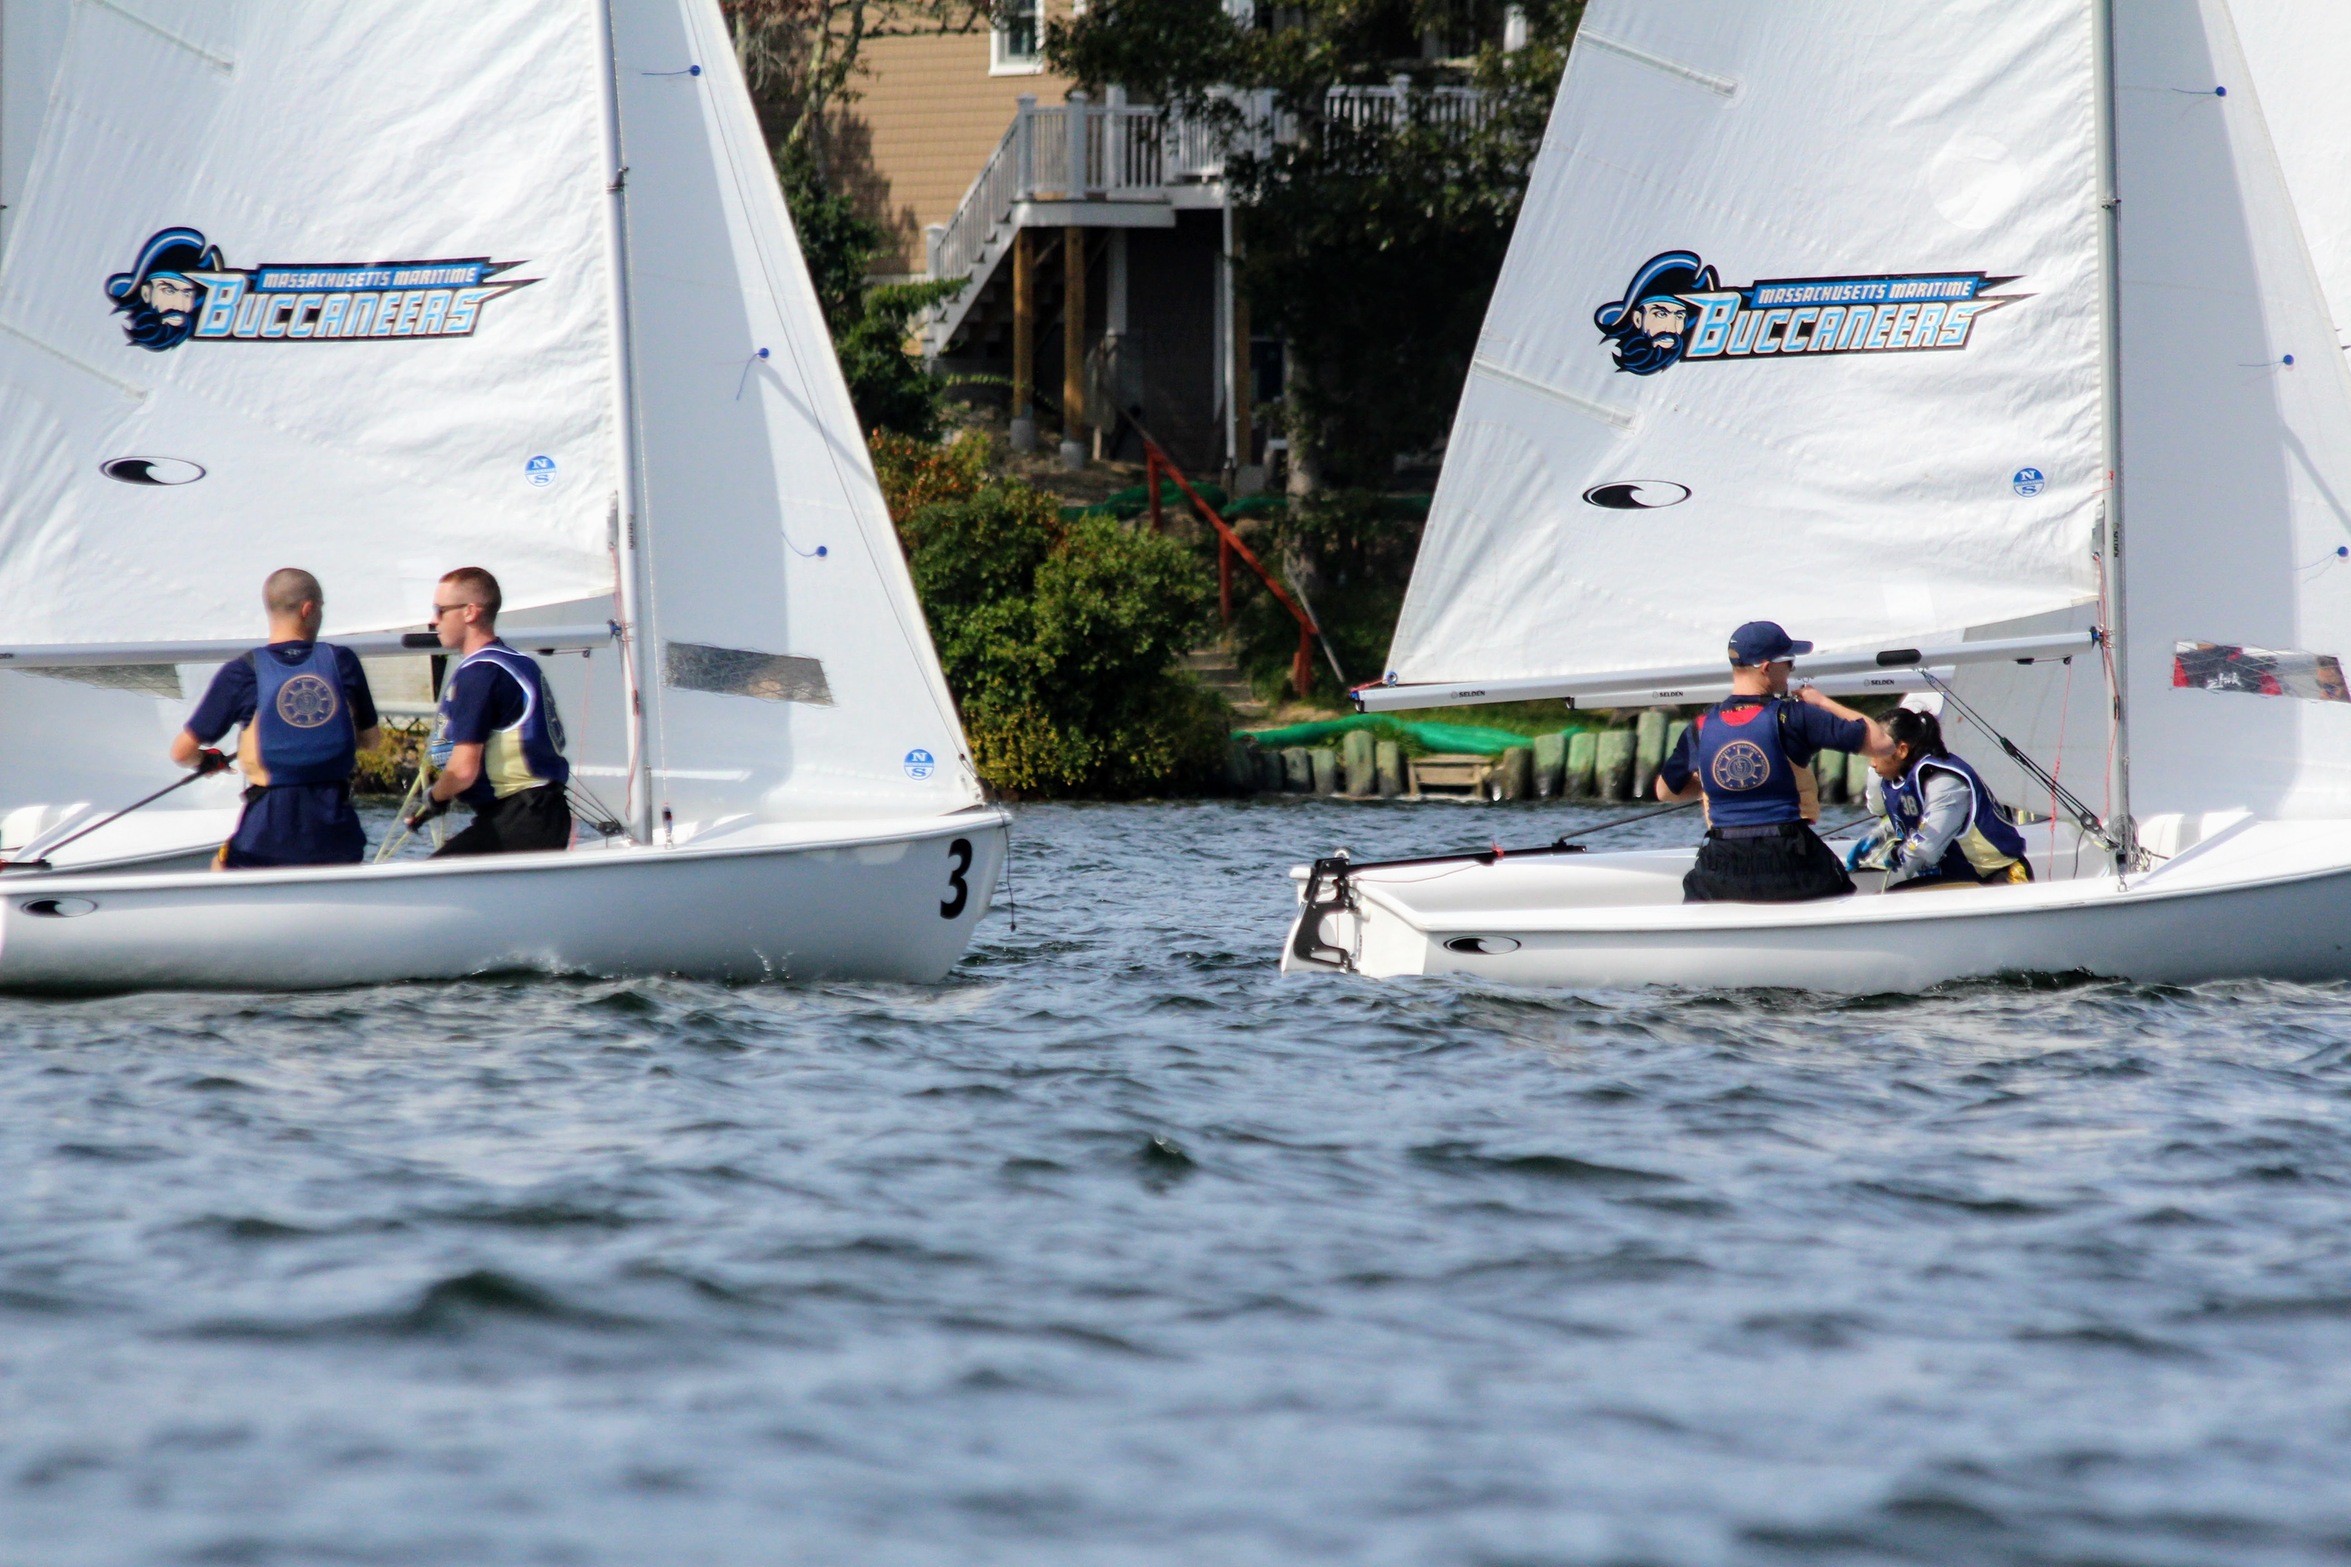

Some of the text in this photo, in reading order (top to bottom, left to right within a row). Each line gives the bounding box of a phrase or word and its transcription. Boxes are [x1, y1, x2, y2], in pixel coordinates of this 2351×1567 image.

[263, 267, 477, 289] MASSACHUSETTS MARITIME
[1758, 281, 1973, 304] MASSACHUSETTS MARITIME
[195, 273, 483, 338] BUCCANEERS
[1685, 291, 1976, 357] BUCCANEERS
[532, 459, 548, 470] N
[534, 474, 550, 484] S
[2020, 470, 2036, 481] N
[2021, 485, 2037, 494] S
[911, 752, 928, 762] N
[911, 767, 927, 777] S
[940, 838, 973, 920] 3
